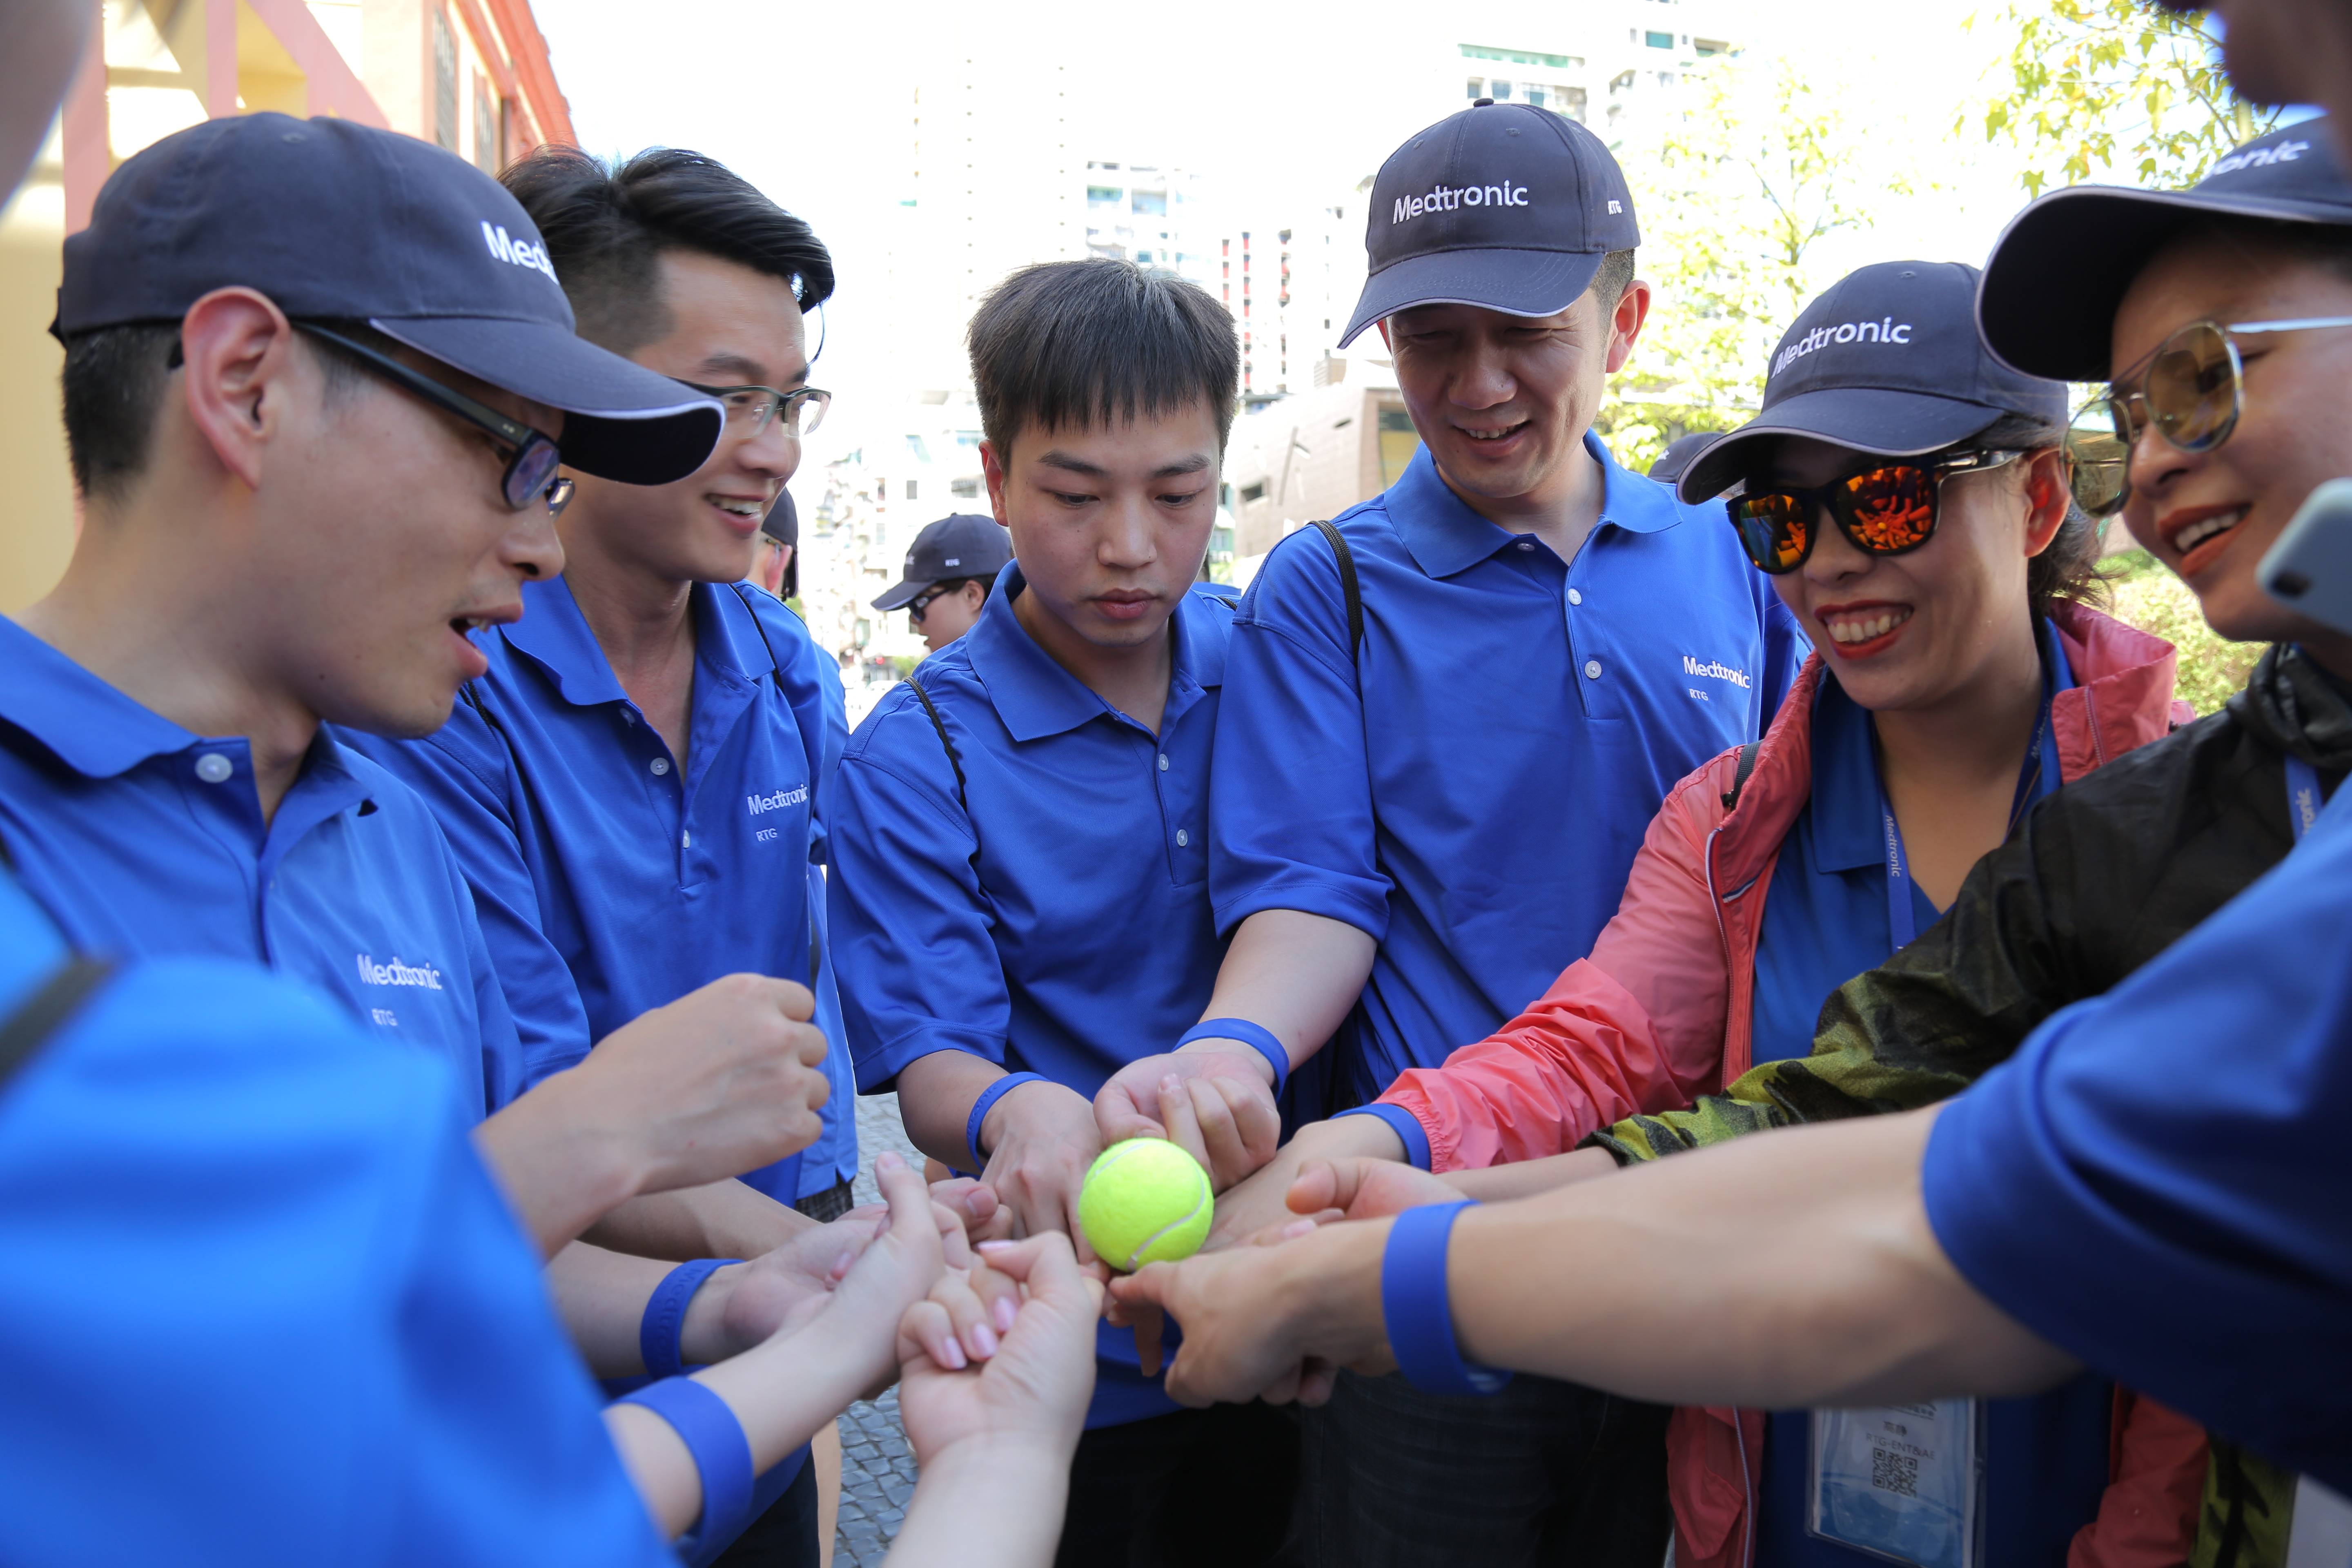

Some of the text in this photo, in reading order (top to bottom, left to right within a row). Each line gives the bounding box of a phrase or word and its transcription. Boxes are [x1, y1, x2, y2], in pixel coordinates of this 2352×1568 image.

[1392, 180, 1528, 224] Medtronic
[1608, 200, 1622, 215] RTG
[1771, 316, 1912, 379] Medtronic
[1683, 655, 1751, 688] Medtronic
[1688, 688, 1709, 701] RTG
[756, 828, 778, 842] RTG
[1885, 815, 1902, 878] Medtronic
[356, 953, 443, 991] Medtronic
[371, 1008, 399, 1027] RTG
